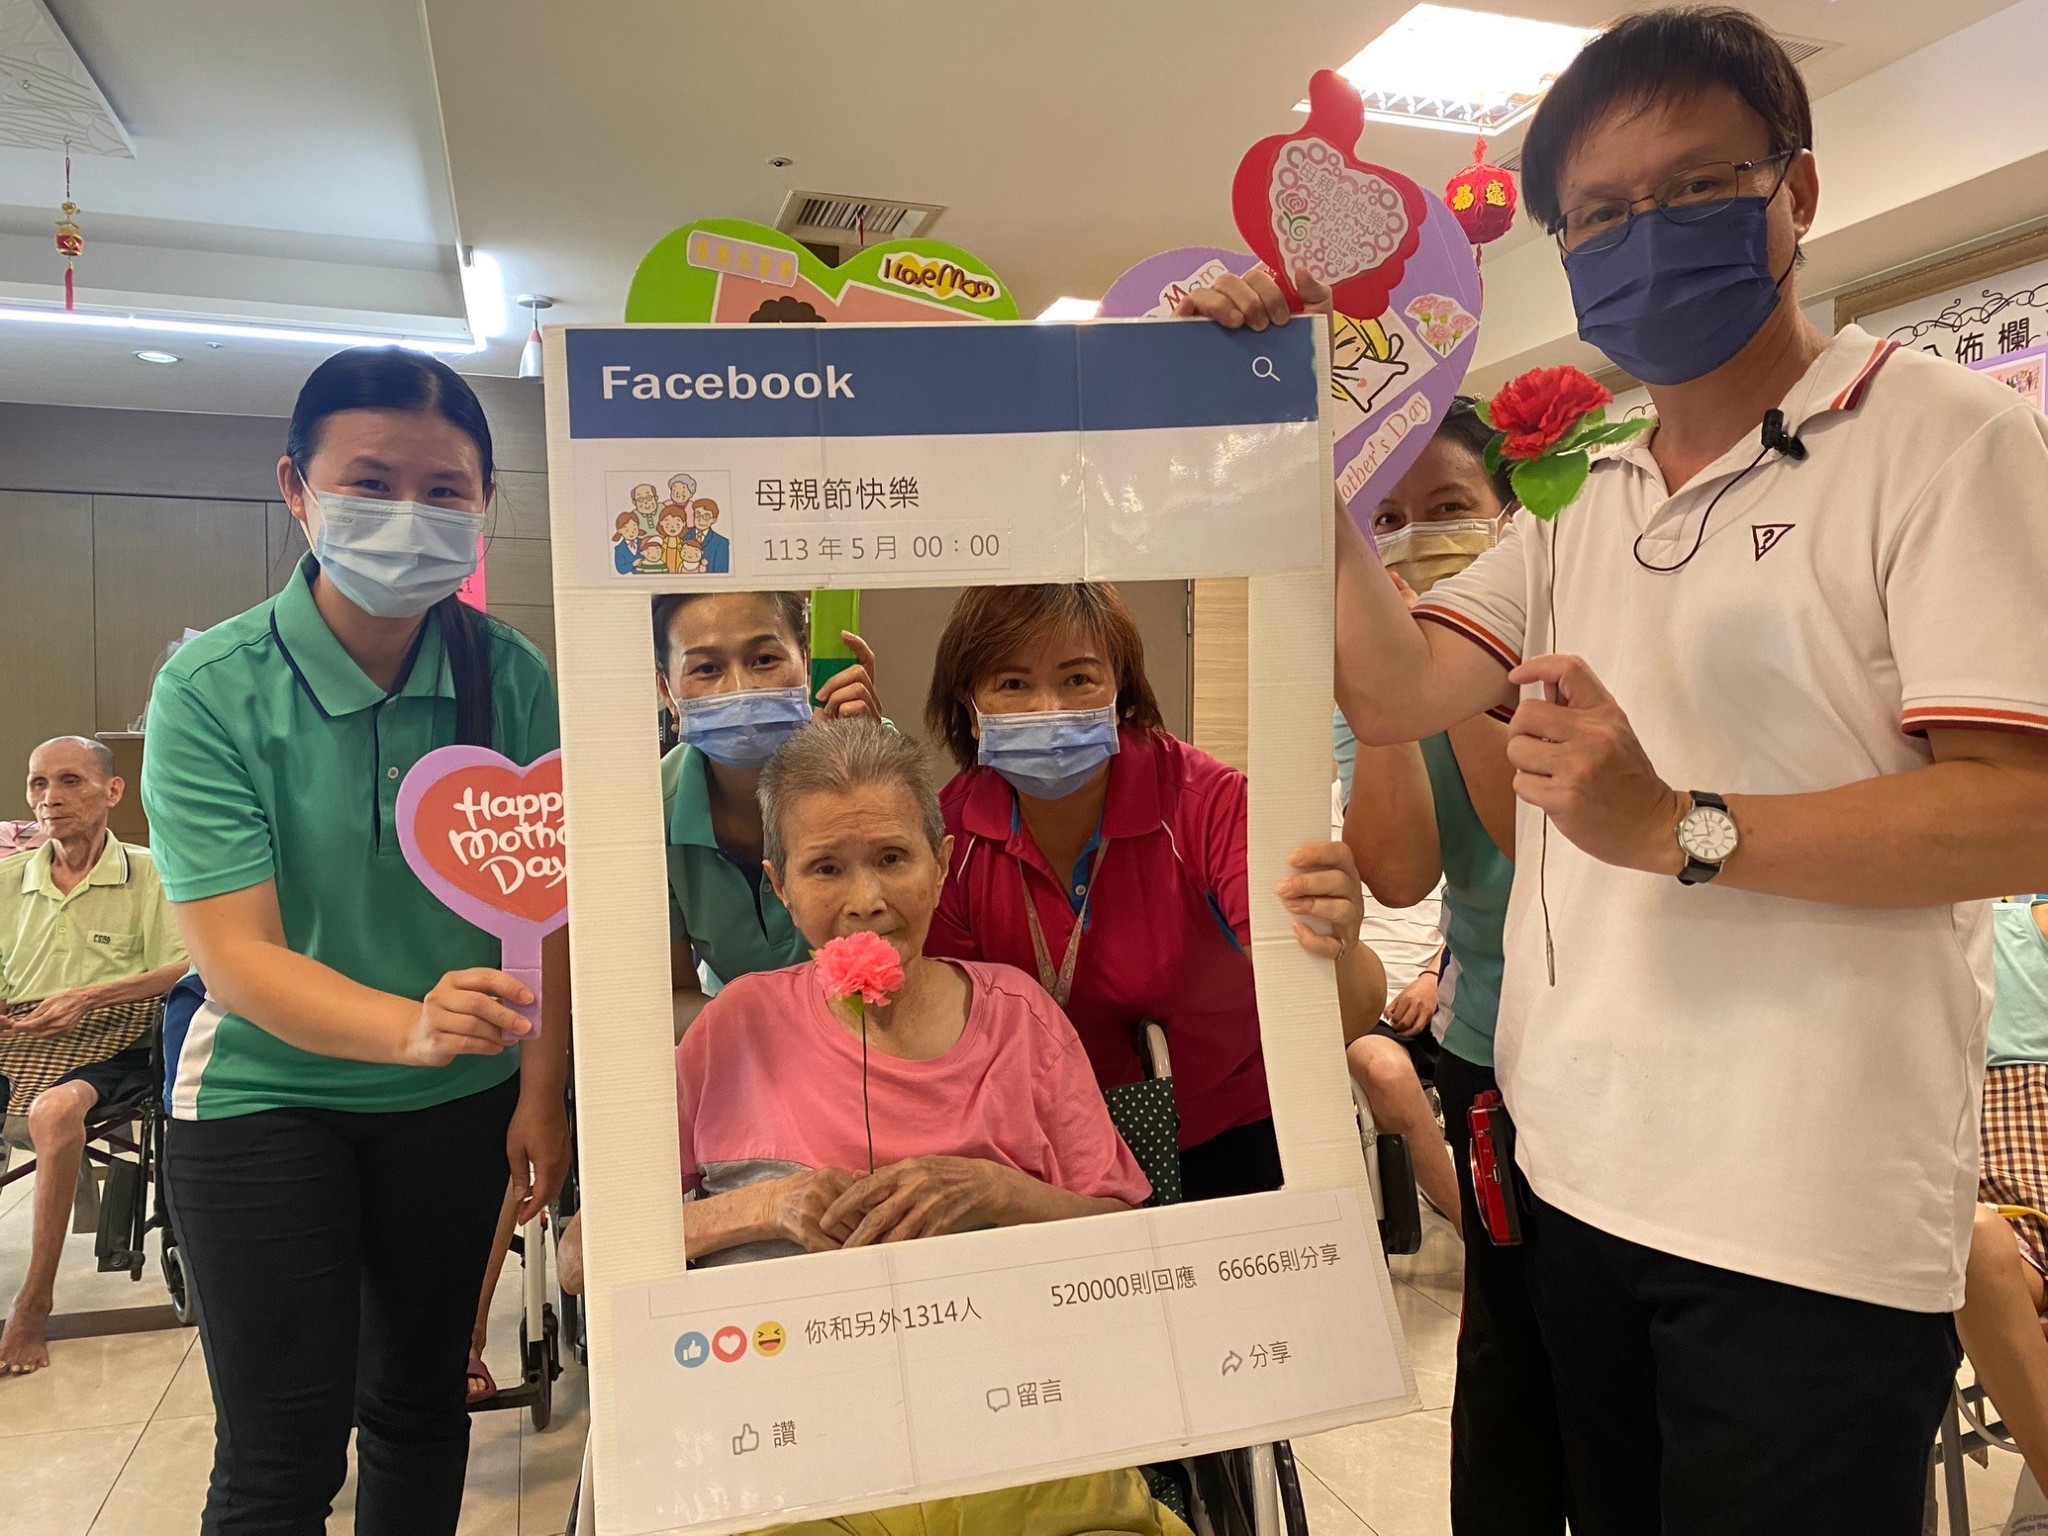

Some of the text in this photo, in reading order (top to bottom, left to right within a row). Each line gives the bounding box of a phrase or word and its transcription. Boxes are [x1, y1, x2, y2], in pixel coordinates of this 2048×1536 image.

[1300, 161, 1387, 232] 母親節快樂
[1320, 202, 1360, 238] Happy
[884, 257, 892, 279] I
[936, 263, 995, 298] Mom
[1326, 249, 1352, 273] Day
[602, 365, 855, 400] Facebook
[1341, 396, 1428, 499] other's Day
[755, 476, 919, 512] 母親節快樂
[479, 855, 567, 895] Day
[1217, 1242, 1341, 1281] 66666則分享
[1051, 1265, 1198, 1307] 520000則回應
[804, 1296, 982, 1345] 你和另外1314人
[1249, 1340, 1292, 1369] 分享
[1016, 1379, 1063, 1408] 留言
[772, 1420, 797, 1448] 讚
